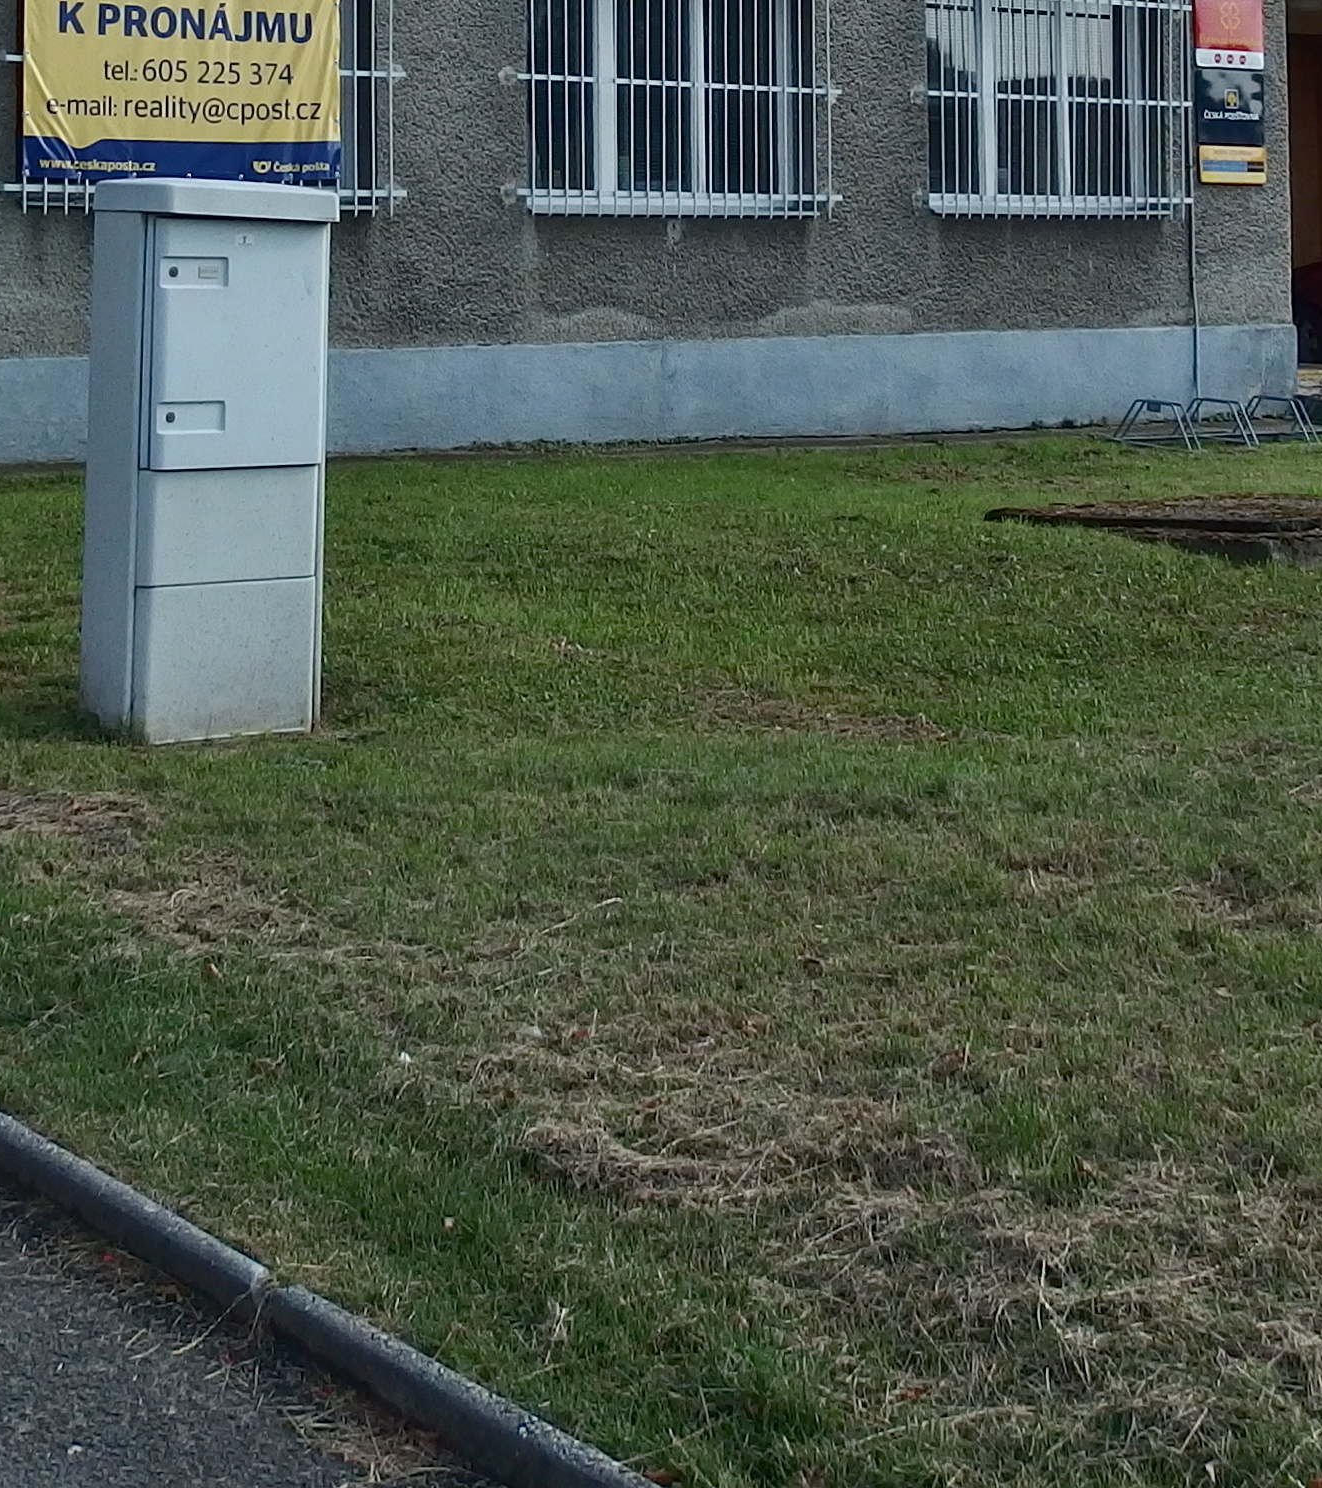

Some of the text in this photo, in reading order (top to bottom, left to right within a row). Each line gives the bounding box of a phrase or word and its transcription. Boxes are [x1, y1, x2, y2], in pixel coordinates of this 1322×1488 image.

[58, 1, 313, 44] K PRONÁJMU
[142, 59, 188, 82] 605
[197, 61, 241, 85] 225
[249, 63, 294, 86] 374
[46, 96, 321, 125] e-mail: reality@cpost.cz
[39, 159, 156, 172] www.ceskaposta.cz
